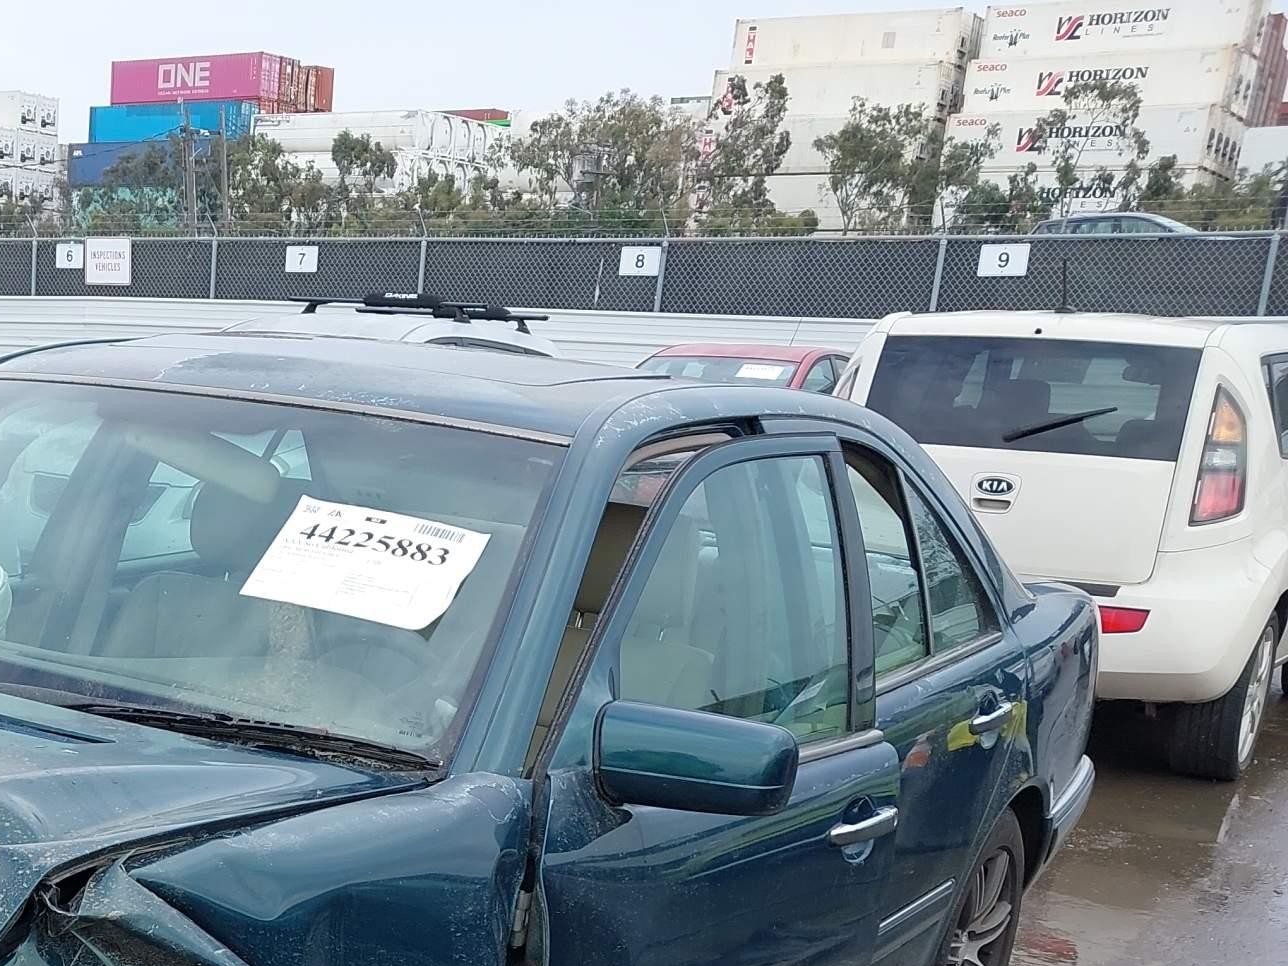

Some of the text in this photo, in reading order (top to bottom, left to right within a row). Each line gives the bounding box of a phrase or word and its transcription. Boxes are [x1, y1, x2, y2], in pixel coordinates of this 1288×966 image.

[996, 7, 1027, 18] seaco
[1087, 8, 1171, 27] HORIZON
[1084, 24, 1155, 36] LINES
[976, 63, 1007, 72] seaco
[157, 62, 211, 88] ONE
[1067, 66, 1150, 83] HORIZON
[956, 117, 987, 127] seaco
[1048, 125, 1127, 139] HORIZON
[66, 250, 73, 262] 6
[90, 250, 126, 260] INSPECTIONS
[297, 253, 306, 266] 7
[997, 251, 1010, 270] 9
[95, 262, 121, 272] VEHICLES
[634, 254, 645, 269] 8
[981, 480, 1008, 491] KIA
[299, 523, 450, 566] 44225883
